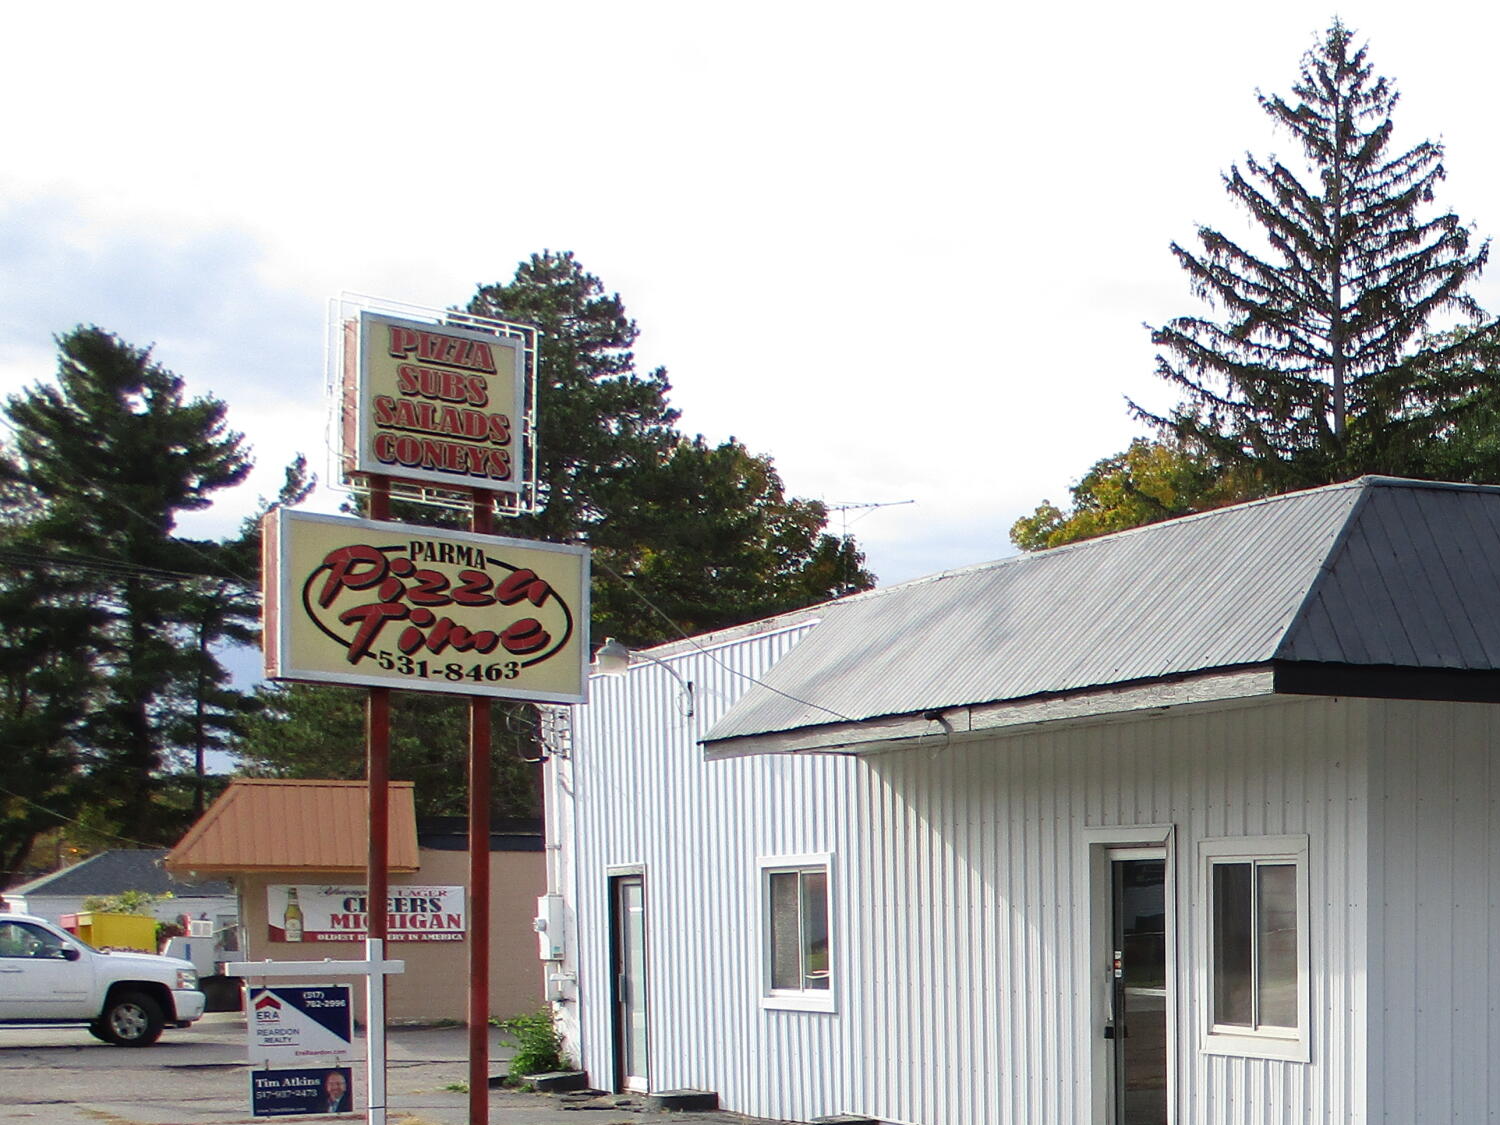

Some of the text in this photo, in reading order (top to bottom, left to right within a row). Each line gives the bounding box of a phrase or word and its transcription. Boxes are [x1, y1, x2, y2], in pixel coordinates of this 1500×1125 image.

[388, 326, 497, 374] PIZZA
[398, 363, 488, 407] SUBS
[374, 394, 512, 446] SALADS
[374, 433, 512, 481] CONEYS
[410, 540, 488, 570] PARMA
[318, 544, 552, 610] Pizza
[338, 601, 553, 665] Time
[378, 651, 521, 682] 531-8463
[343, 897, 442, 913] CERS
[398, 889, 448, 897] LAGER
[329, 913, 462, 929] MIIGAN
[317, 933, 354, 941] OLDEST
[408, 933, 419, 941] IN
[421, 933, 464, 941] AMERICA
[256, 1011, 280, 1020] ERA
[256, 1028, 300, 1036] REARDON
[256, 1076, 321, 1088] Tim Atkins
